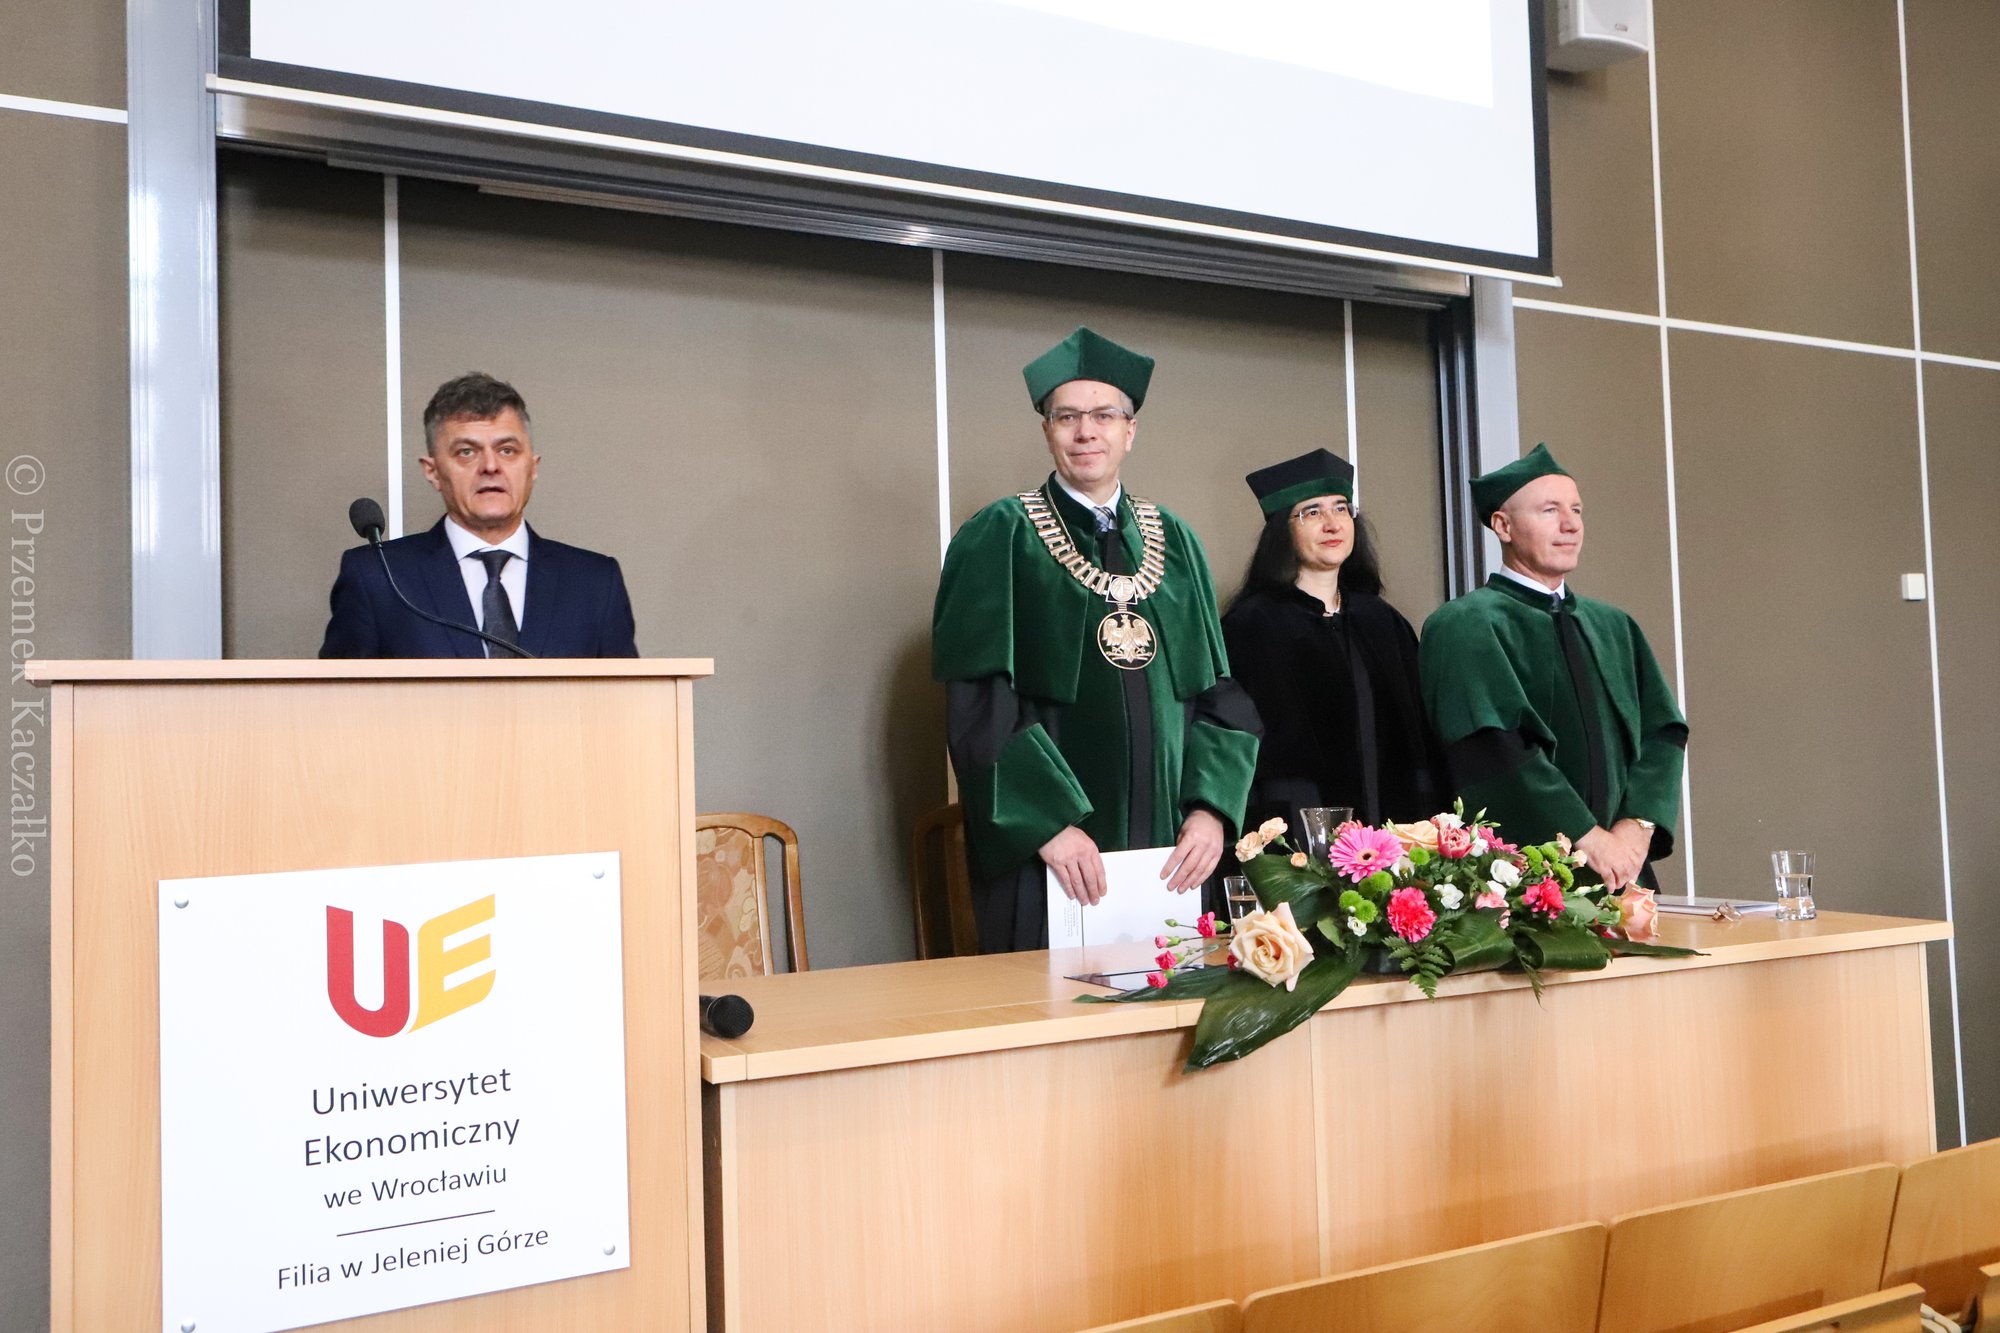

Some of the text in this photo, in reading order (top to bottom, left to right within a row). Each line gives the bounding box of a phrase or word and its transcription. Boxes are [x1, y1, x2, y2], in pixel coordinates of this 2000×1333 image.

[326, 893, 497, 1039] UE
[312, 1068, 512, 1115] Uniwersytet
[305, 1118, 520, 1167] Ekonomiczny
[323, 1164, 507, 1209] we Wrocławiu
[278, 1230, 549, 1290] Filia w Jeleniej Górze
